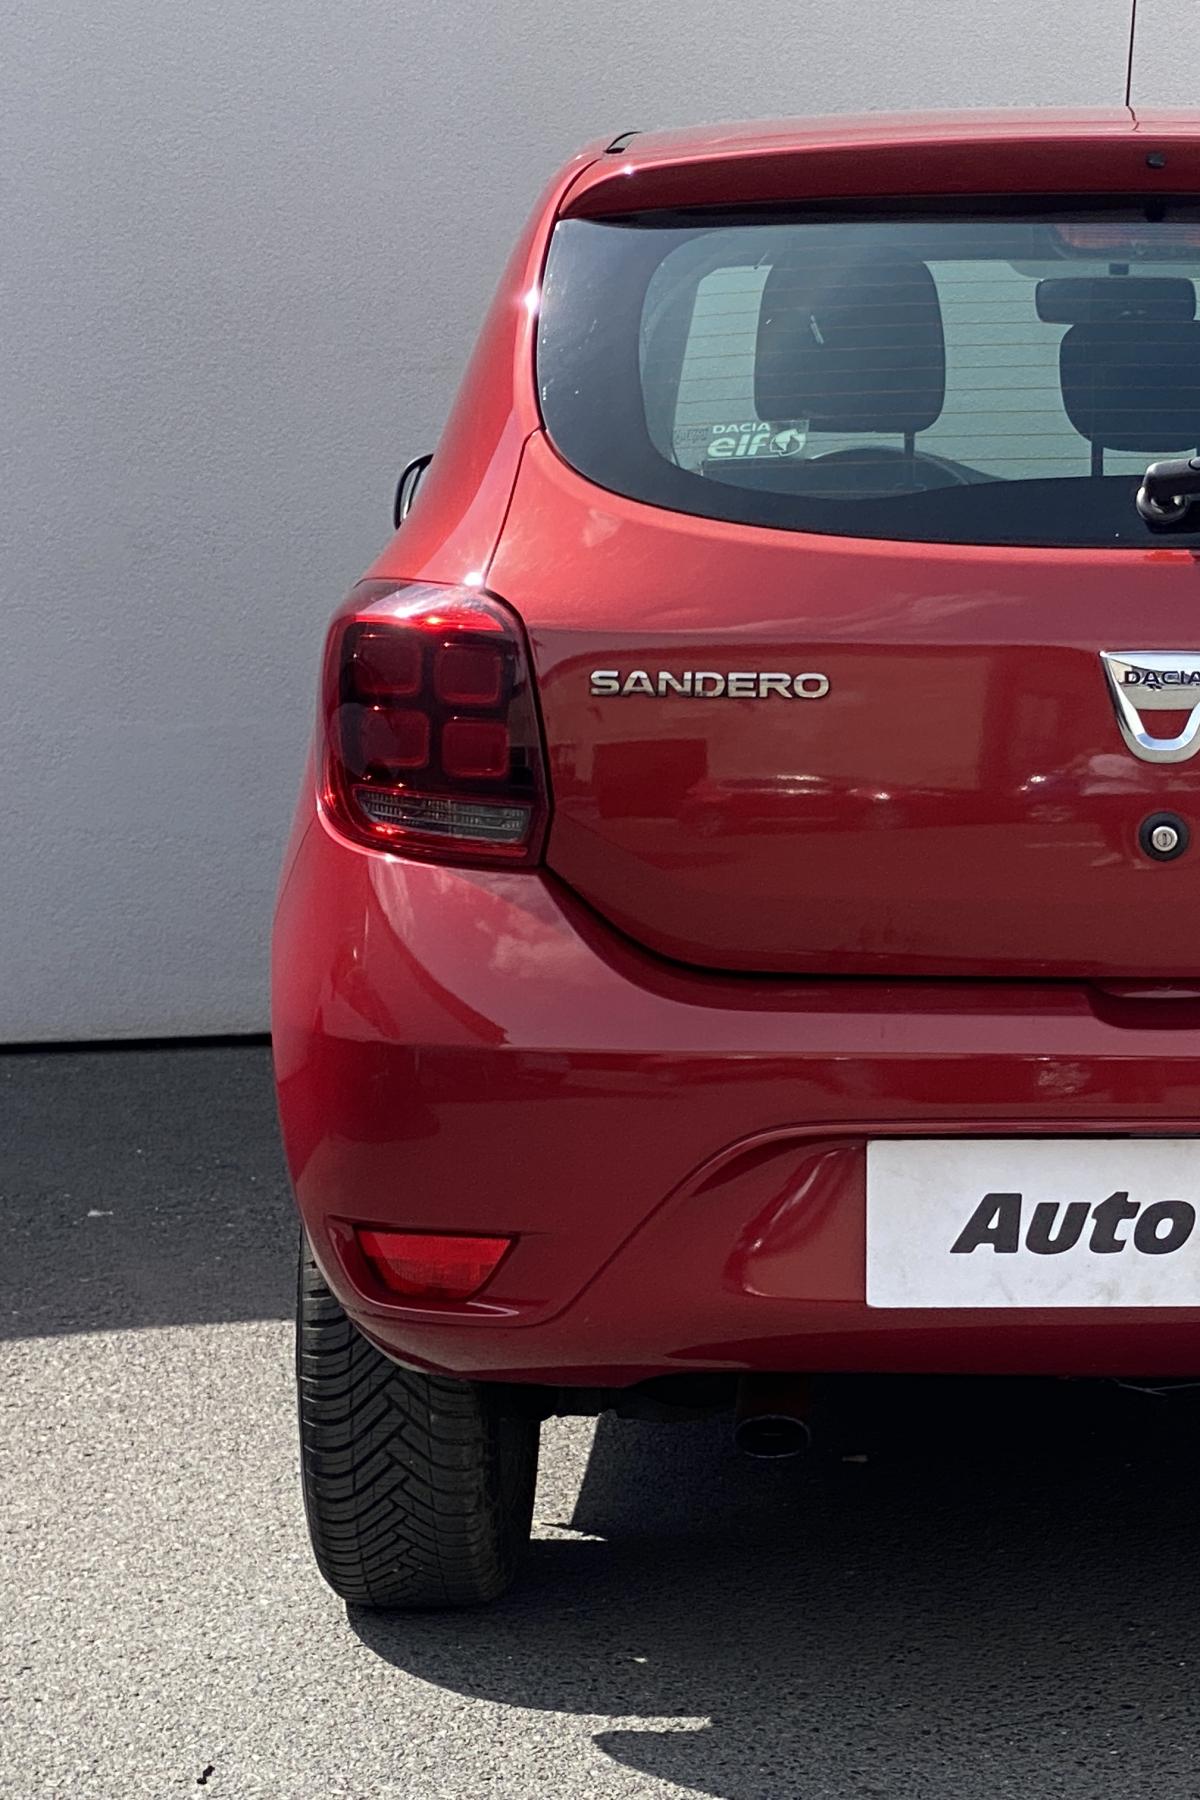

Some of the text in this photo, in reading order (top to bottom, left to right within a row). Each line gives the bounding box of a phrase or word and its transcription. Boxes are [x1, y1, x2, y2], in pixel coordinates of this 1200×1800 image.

[712, 422, 771, 434] DACIA
[707, 434, 771, 457] elf
[589, 669, 831, 699] SANDERO
[950, 1191, 1197, 1255] Auto
